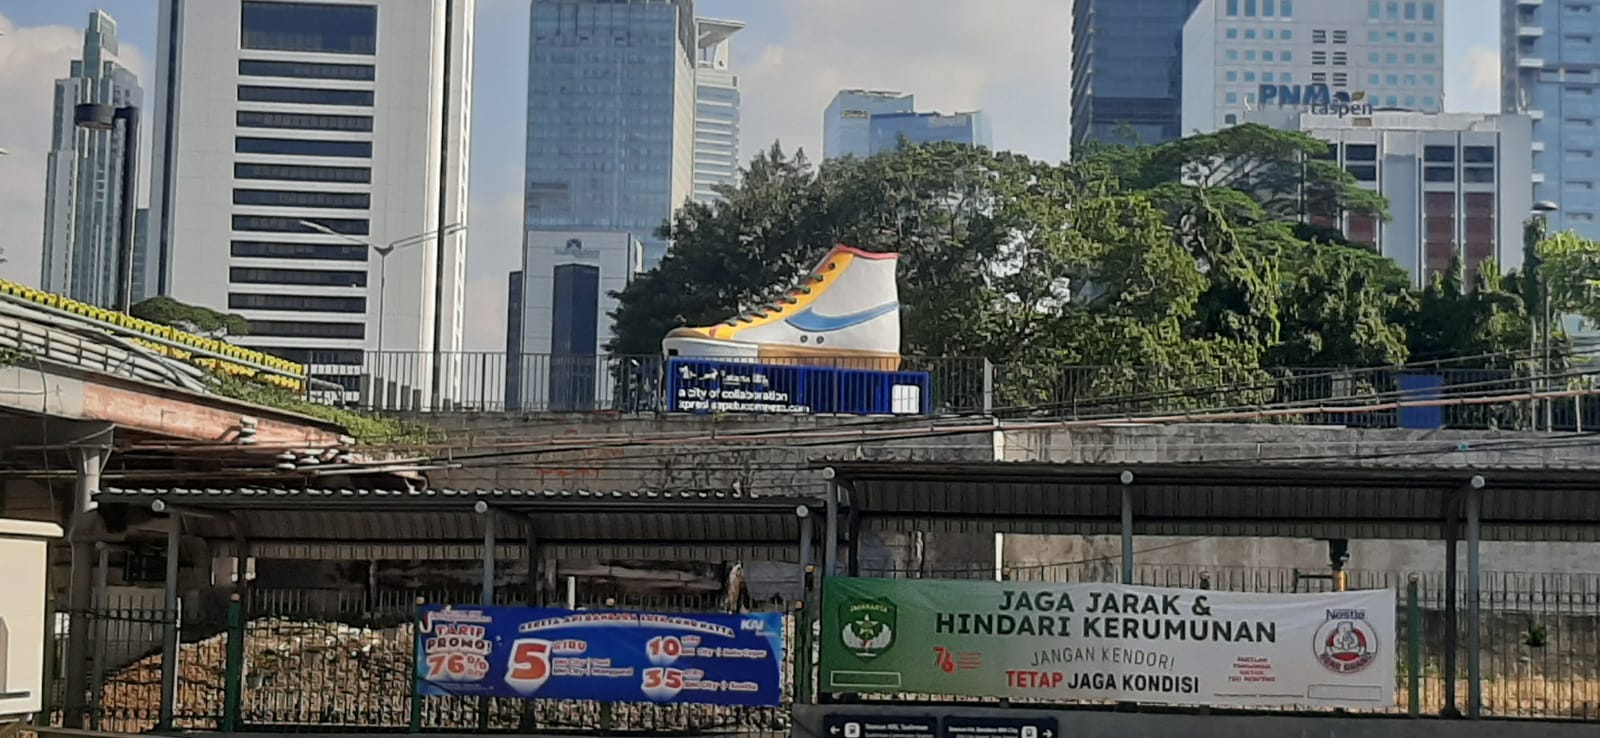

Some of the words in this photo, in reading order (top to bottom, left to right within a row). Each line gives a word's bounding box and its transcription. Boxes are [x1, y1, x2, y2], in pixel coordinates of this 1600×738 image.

[1258, 84, 1331, 106] PNM
[1311, 101, 1372, 119] taspen
[721, 389, 788, 402] collaboration
[998, 591, 1074, 613] JAGA
[1085, 593, 1180, 616] JARAK
[1191, 595, 1212, 616] &
[437, 625, 484, 637] TARIF
[936, 613, 1071, 638] HINDARI
[1083, 616, 1276, 643] KERUMUNAN
[427, 637, 491, 651] PROMO!
[648, 637, 681, 657] 10
[511, 643, 547, 681] 5
[1031, 647, 1096, 666] JANGAN
[645, 668, 683, 688] 35
[1006, 670, 1064, 690] TETAP
[1067, 673, 1117, 692] JAGA
[1122, 674, 1199, 694] KONDISI
